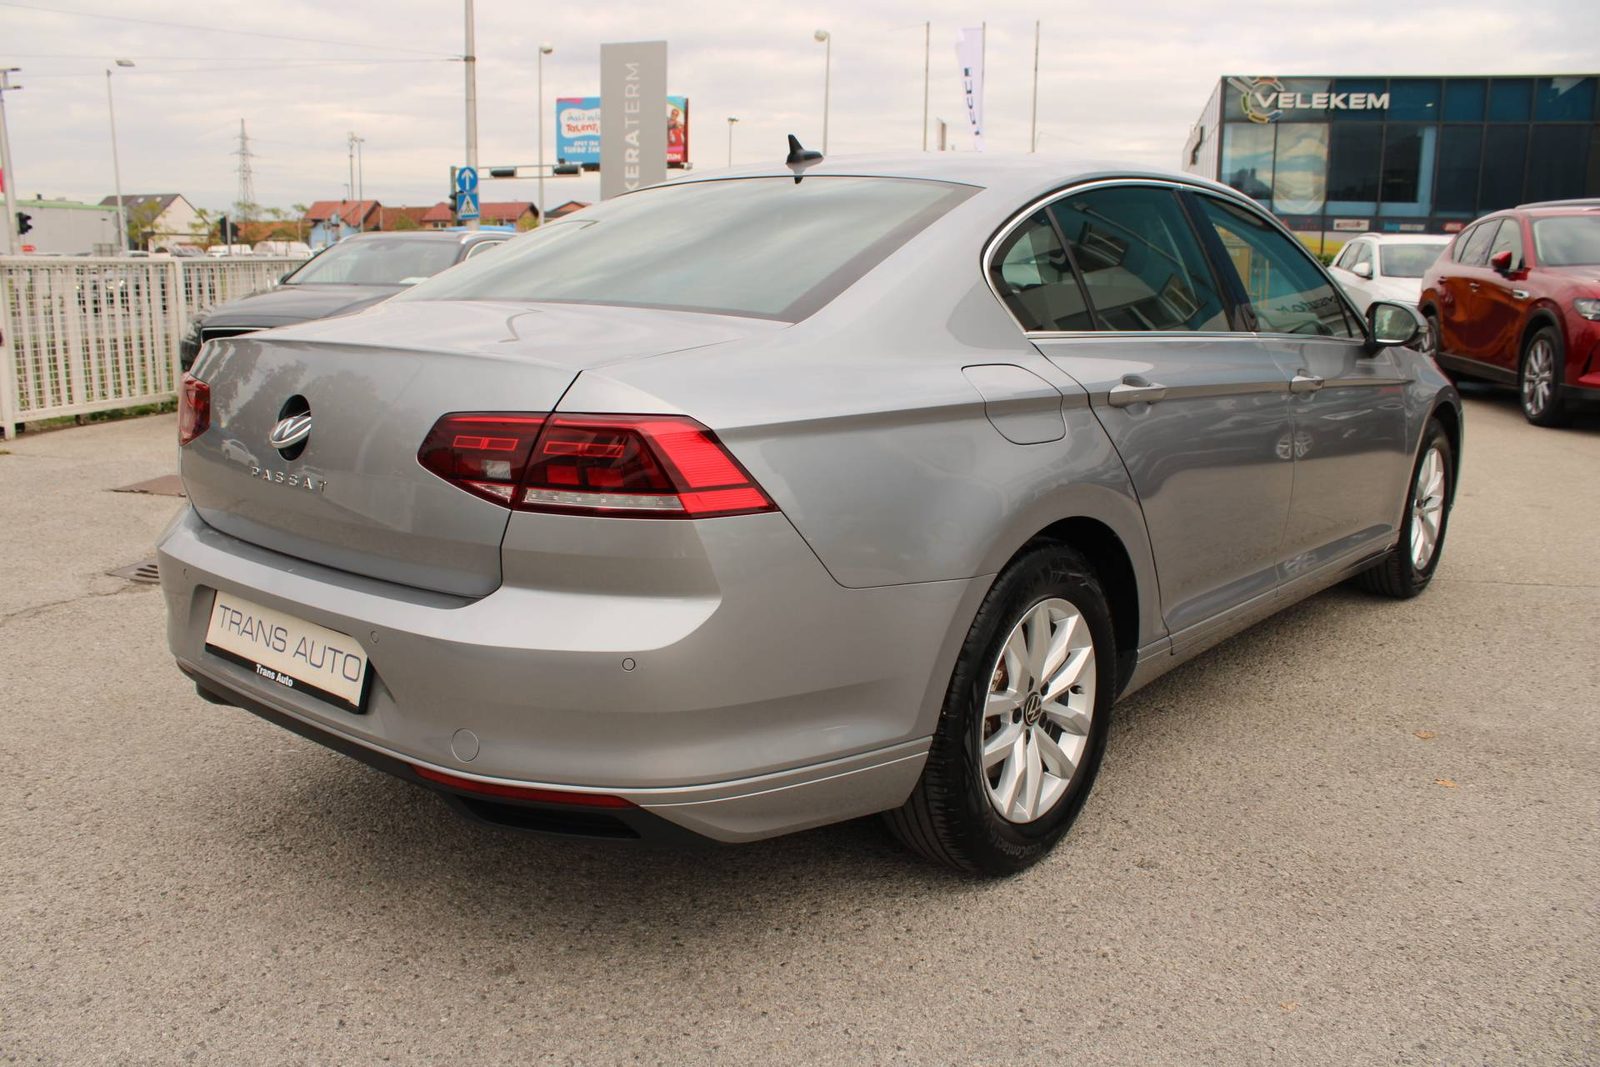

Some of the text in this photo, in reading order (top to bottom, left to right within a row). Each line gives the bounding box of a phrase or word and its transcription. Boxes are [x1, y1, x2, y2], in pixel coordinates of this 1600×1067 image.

[1254, 92, 1391, 110] VELEKEM
[624, 62, 640, 191] KERATERM
[250, 466, 328, 492] PASSAT
[219, 604, 362, 683] TRANS AUTO
[255, 663, 294, 687] Trans Auto
